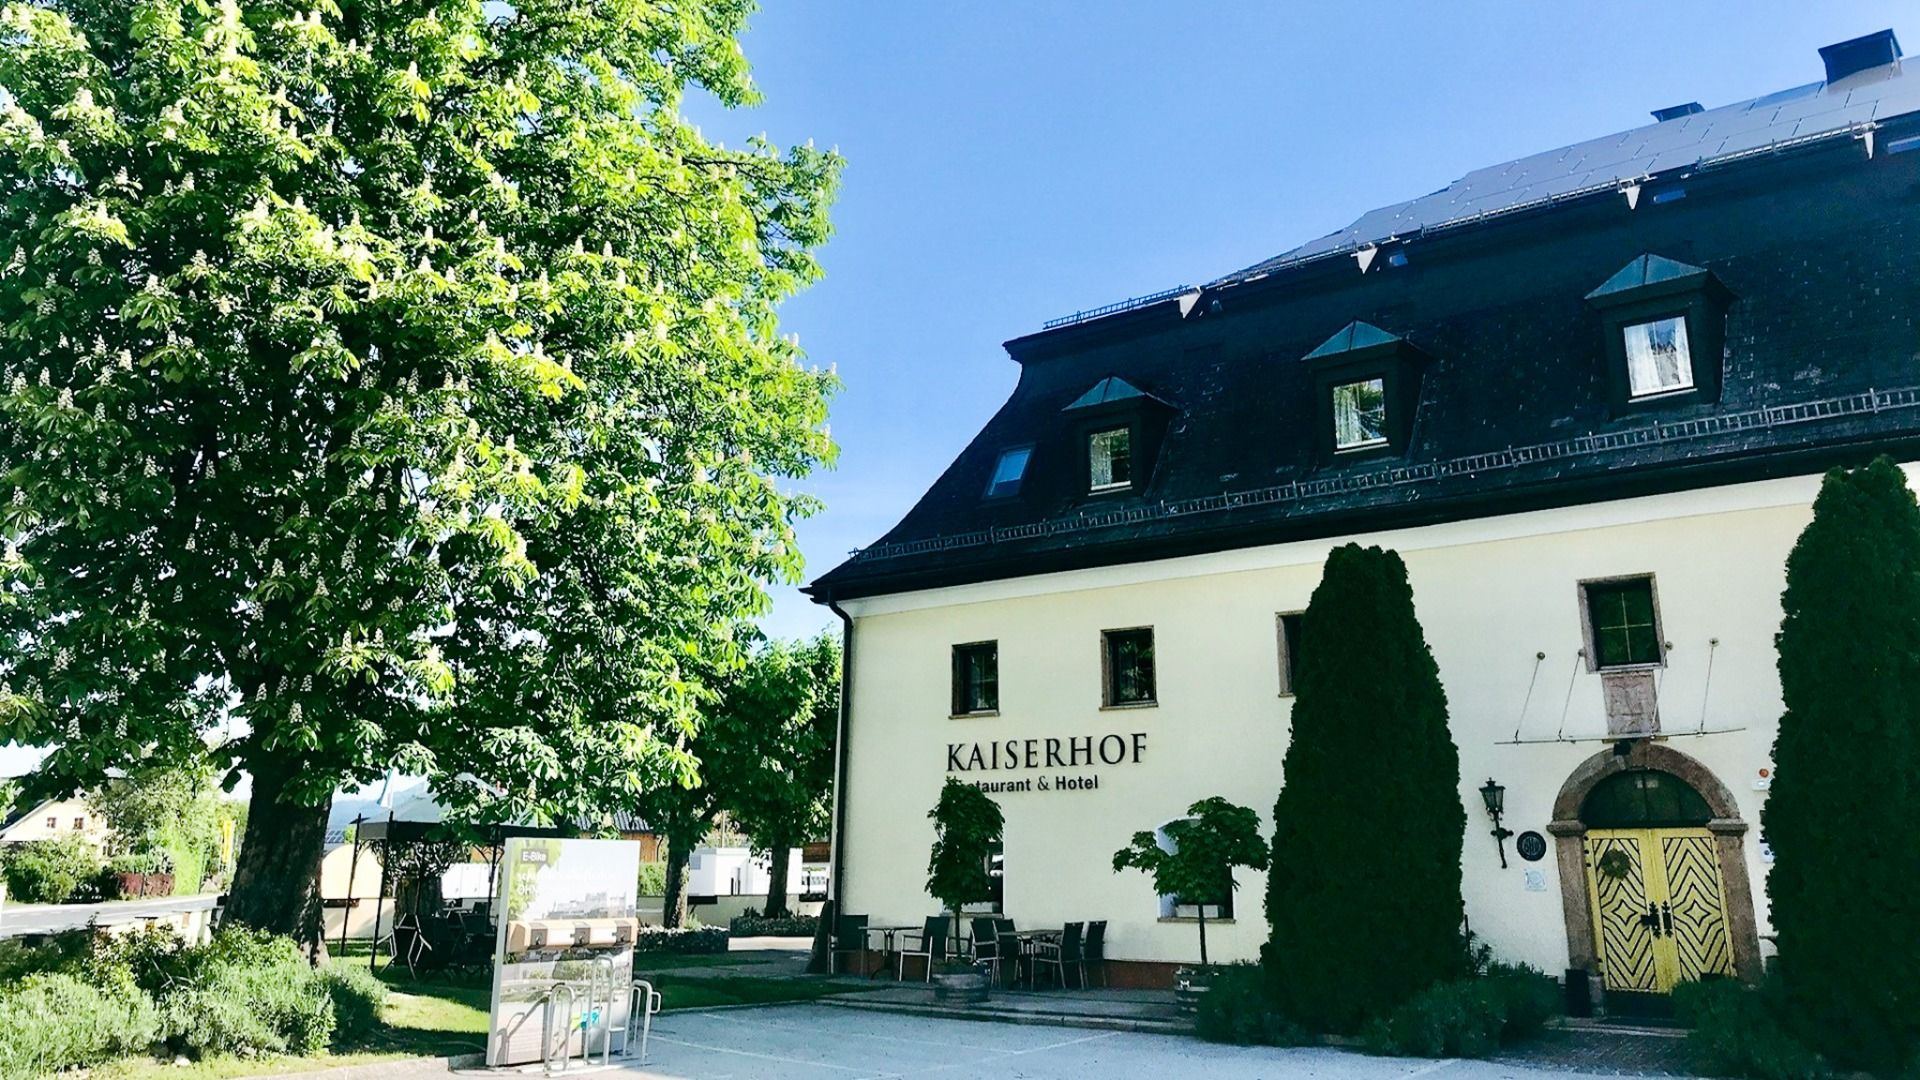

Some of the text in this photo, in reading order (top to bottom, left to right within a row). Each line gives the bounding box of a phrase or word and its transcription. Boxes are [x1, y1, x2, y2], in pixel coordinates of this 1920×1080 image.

[946, 733, 1147, 772] KAISERHOF
[967, 774, 1099, 793] taurant & Hotel
